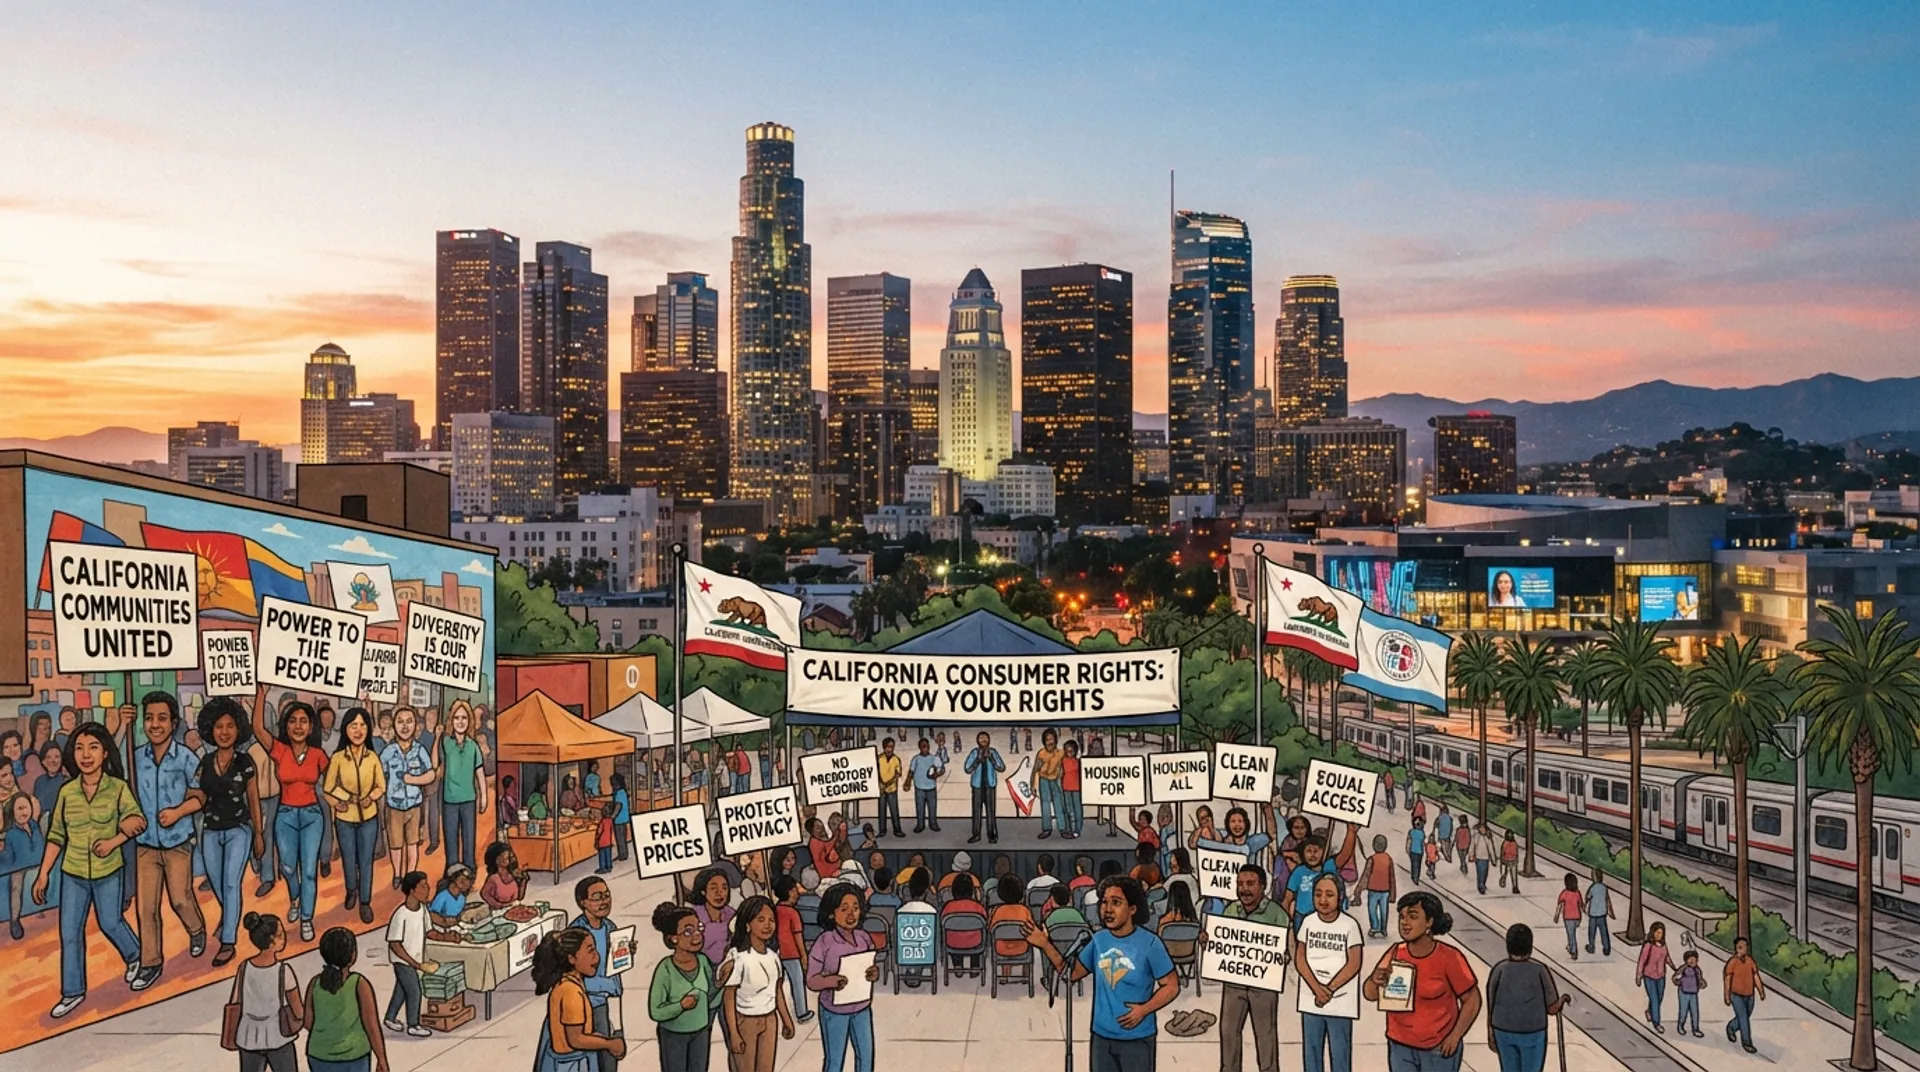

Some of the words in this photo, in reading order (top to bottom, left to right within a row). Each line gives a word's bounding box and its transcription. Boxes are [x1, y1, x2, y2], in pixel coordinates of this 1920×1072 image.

[60, 555, 190, 592] CALIFORNIA
[61, 592, 192, 625] COMMUNITIES
[266, 607, 333, 639] POWER
[337, 621, 360, 644] TO
[84, 627, 173, 658] UNITED
[297, 637, 331, 661] THE
[424, 636, 437, 653] IS
[440, 639, 467, 660] OUR
[208, 654, 226, 670] TO
[228, 654, 251, 669] THE
[274, 656, 346, 688] PEOPLE
[802, 658, 939, 685] CALIFORNIA
[946, 662, 1070, 685] CONSUMER
[1077, 660, 1164, 684] RIGHTS:
[862, 687, 938, 711] KNOW
[945, 690, 1010, 712] YOUR
[1019, 688, 1104, 712] RIGHTS
[831, 756, 849, 769] NO
[1152, 760, 1207, 775] HOUSING
[1220, 752, 1269, 773] CLEAN
[1169, 775, 1193, 791] ALL
[1229, 773, 1256, 791] AIR
[1308, 789, 1366, 815] ACCESS
[650, 817, 689, 841] FAIR
[643, 838, 704, 866] PRICES
